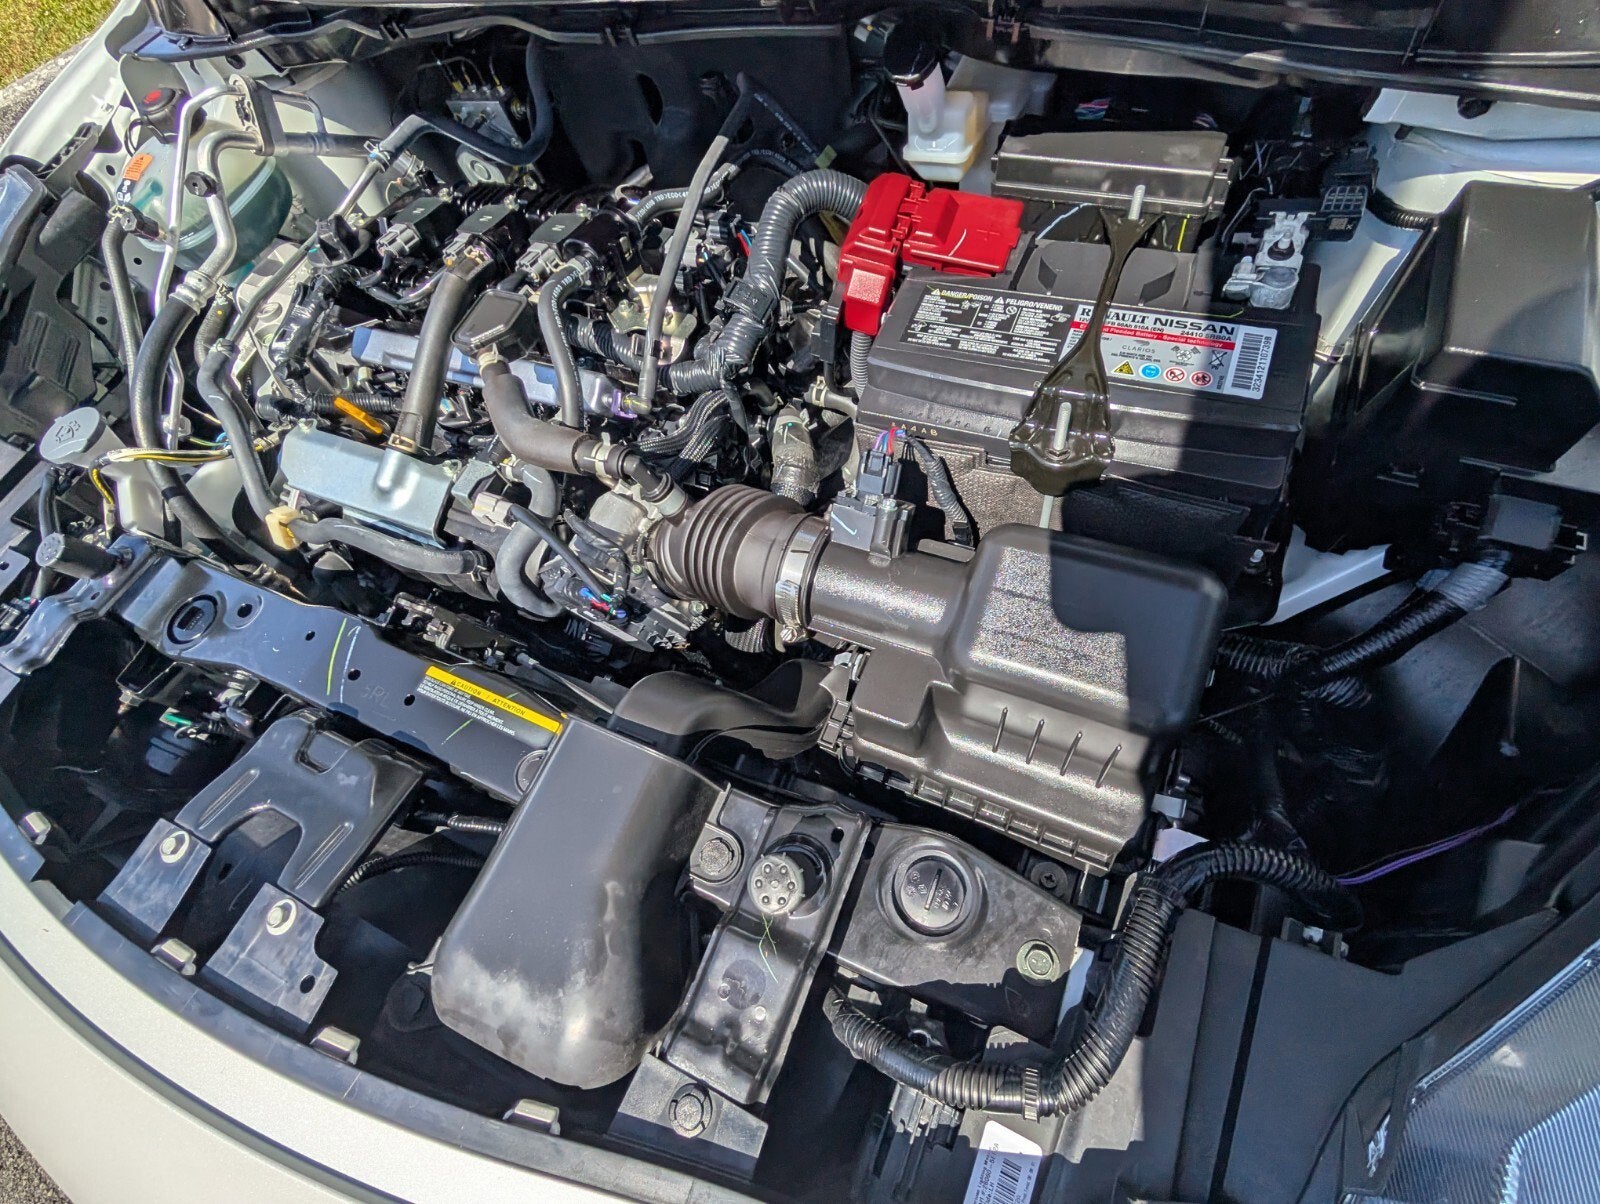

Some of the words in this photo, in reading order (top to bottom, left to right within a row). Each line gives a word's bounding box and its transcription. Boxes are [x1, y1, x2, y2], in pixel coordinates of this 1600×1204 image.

[941, 289, 992, 302] DANGER/POISON
[1005, 297, 1062, 311] PELIGRO/VENENO
[1079, 307, 1150, 324] RNAULT
[1153, 317, 1235, 335] NISSAN
[1122, 344, 1155, 353] CLARIOS
[1135, 331, 1157, 339] Battery
[1162, 334, 1185, 343] Special
[1186, 338, 1223, 348] technology
[456, 681, 481, 696] CAUTION
[492, 697, 525, 716] ATTENTION
